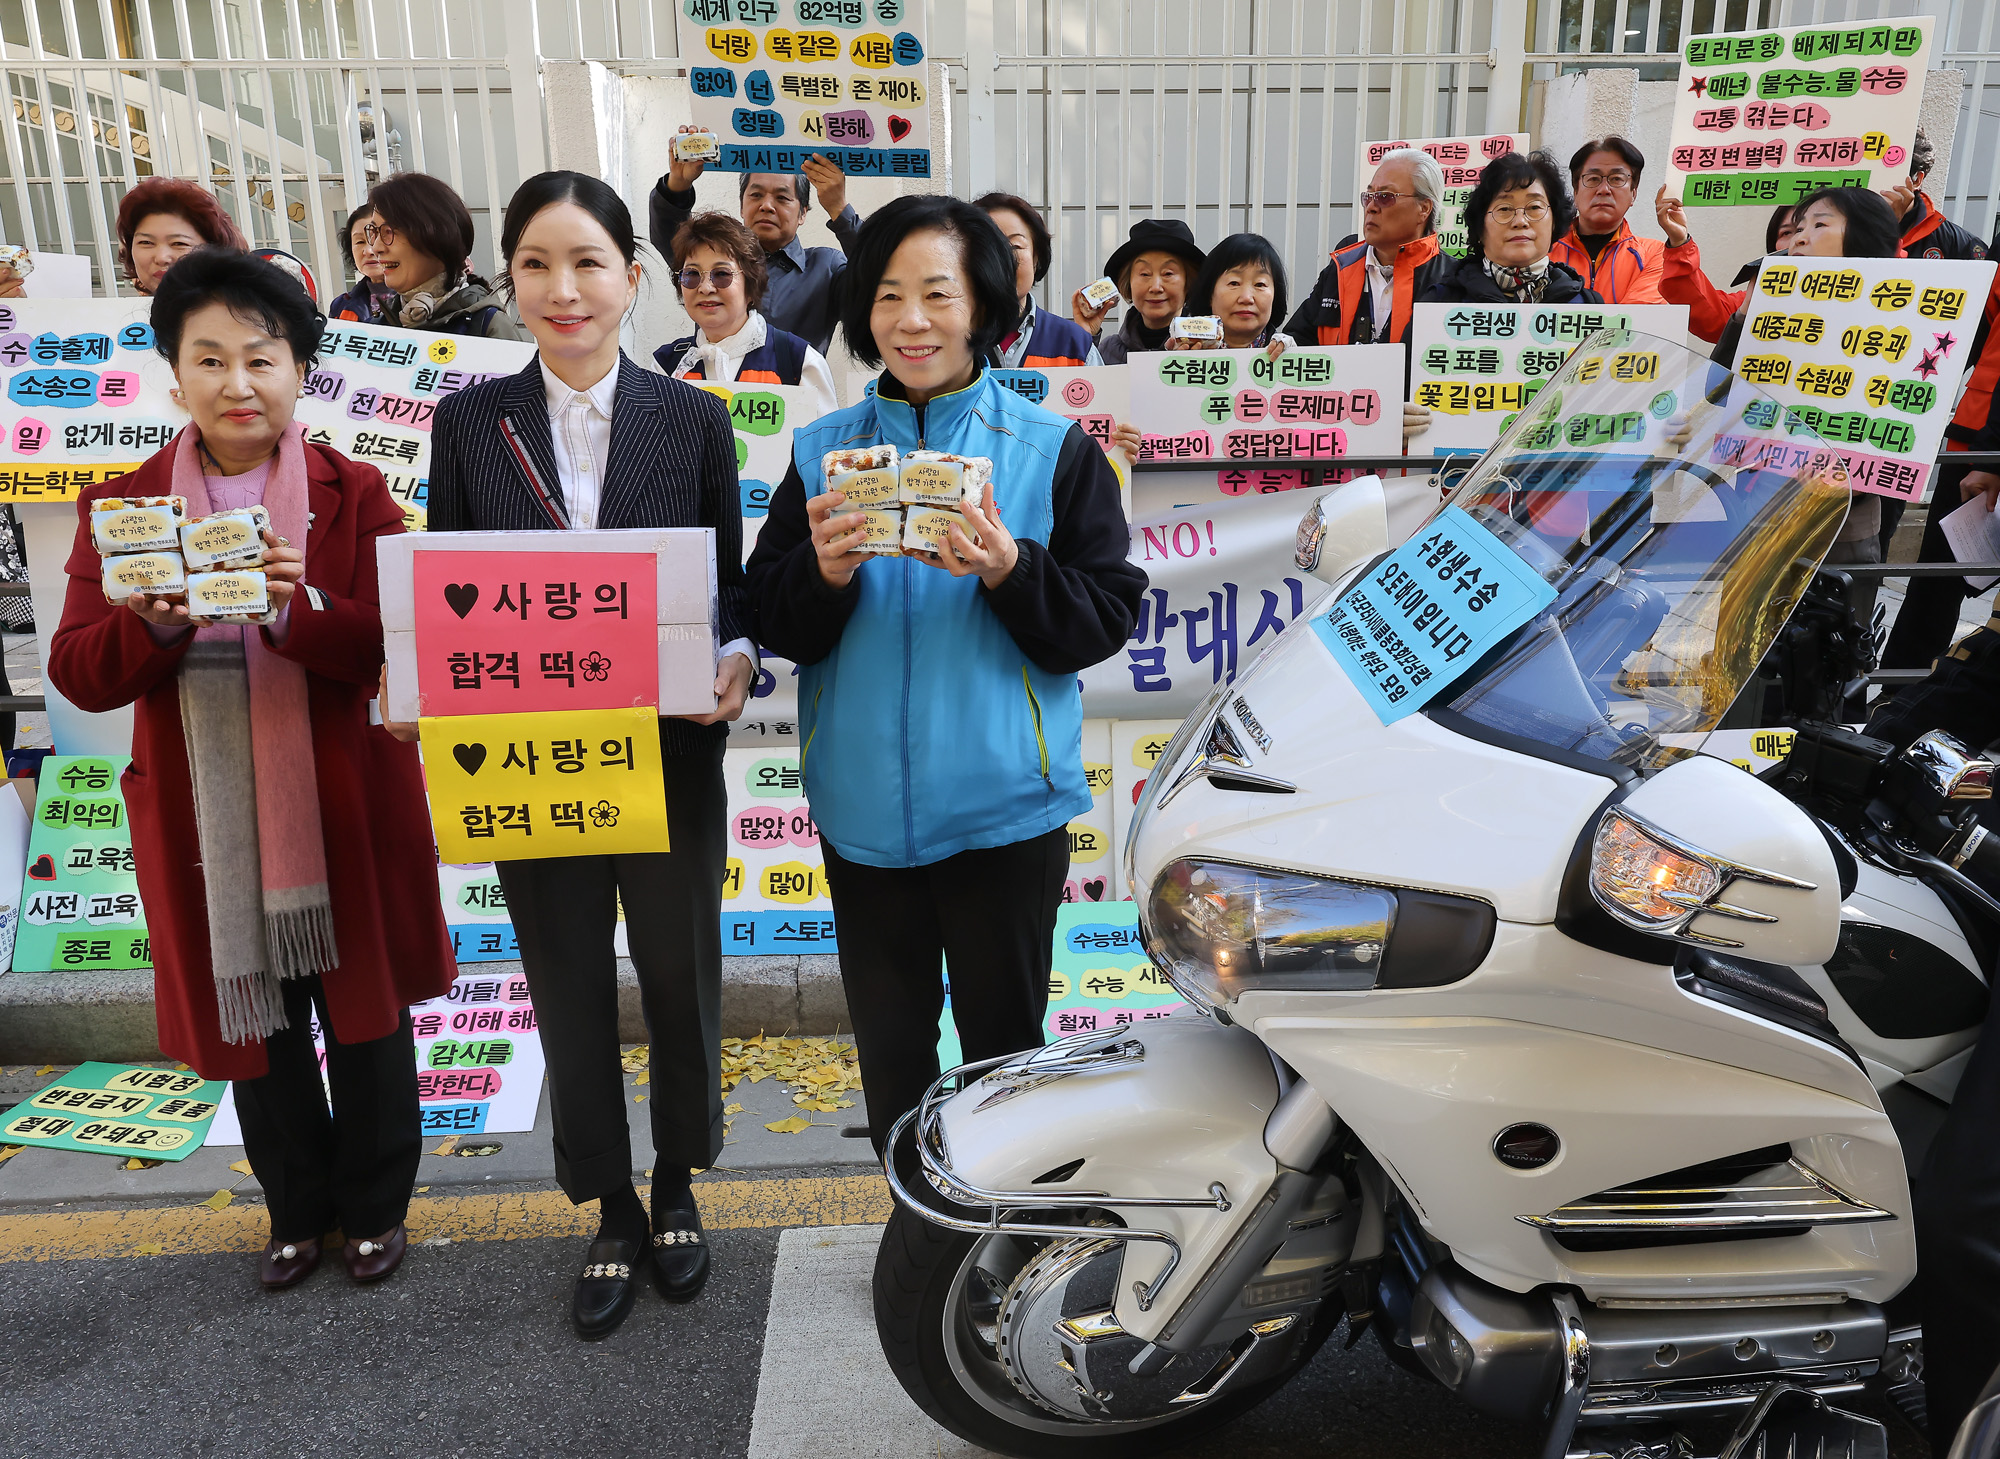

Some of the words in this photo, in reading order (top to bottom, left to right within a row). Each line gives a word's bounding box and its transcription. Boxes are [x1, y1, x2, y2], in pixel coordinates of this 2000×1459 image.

[737, 1, 778, 22] 인구
[799, 0, 862, 24] 82억명
[876, 0, 899, 19] 중
[711, 33, 751, 57] 너랑
[852, 38, 919, 64] 사람은
[1689, 37, 1781, 63] 킬러문항
[1793, 29, 1917, 56] 배제되지만
[694, 71, 734, 93] 없어
[750, 77, 771, 101] 넌
[780, 74, 840, 99] 특별한
[1709, 75, 1748, 97] 매년
[737, 111, 778, 136] 정말
[1698, 108, 1738, 129] 고통
[1675, 142, 1784, 168] 적정변별력
[1796, 136, 1885, 164] 유지하라
[1693, 179, 1732, 201] 대한
[1740, 178, 1780, 199] 인명
[1762, 269, 1798, 295] 국민
[1800, 273, 1862, 300] 여러분!
[1871, 281, 1913, 308] 수능
[1920, 289, 1966, 320] 당일
[1447, 311, 1517, 337] 수험생
[1751, 315, 1825, 343] 대중교통
[1840, 330, 1910, 361] 이용과
[1161, 358, 1231, 385] 수험생
[1252, 356, 1332, 382] 여러분!
[1425, 349, 1500, 374] 목표를
[1615, 354, 1658, 380] 길이
[16, 375, 128, 399] 소송으로
[1741, 356, 1792, 385] 주변의
[1796, 366, 1853, 397] 수험생
[1868, 378, 1934, 413] 격려와
[1743, 402, 1777, 429] 응원
[64, 422, 115, 450] 없게
[351, 432, 420, 464] 없도록
[1141, 519, 1218, 561] NO!
[492, 581, 628, 621] 사랑의
[1375, 562, 1473, 663] 오토바이입니다
[446, 650, 521, 690] 합격
[539, 650, 575, 688] 떡
[1231, 695, 1274, 756] HONDA
[500, 736, 635, 776] 사랑의
[61, 765, 110, 789] 수능
[44, 799, 120, 828] 최악의
[459, 803, 533, 839] 합격
[550, 800, 586, 834] 떡
[769, 871, 813, 896] 많이
[28, 894, 78, 921] 사전
[88, 894, 139, 918] 교육
[733, 921, 756, 946] 더
[61, 939, 112, 964] 종로
[1086, 976, 1125, 994] 수능
[432, 1043, 511, 1067] 감사를
[121, 1070, 201, 1092] 시험장
[38, 1089, 146, 1113] 반입금지
[13, 1116, 75, 1136] 절대
[76, 1123, 159, 1146] 안돼요
